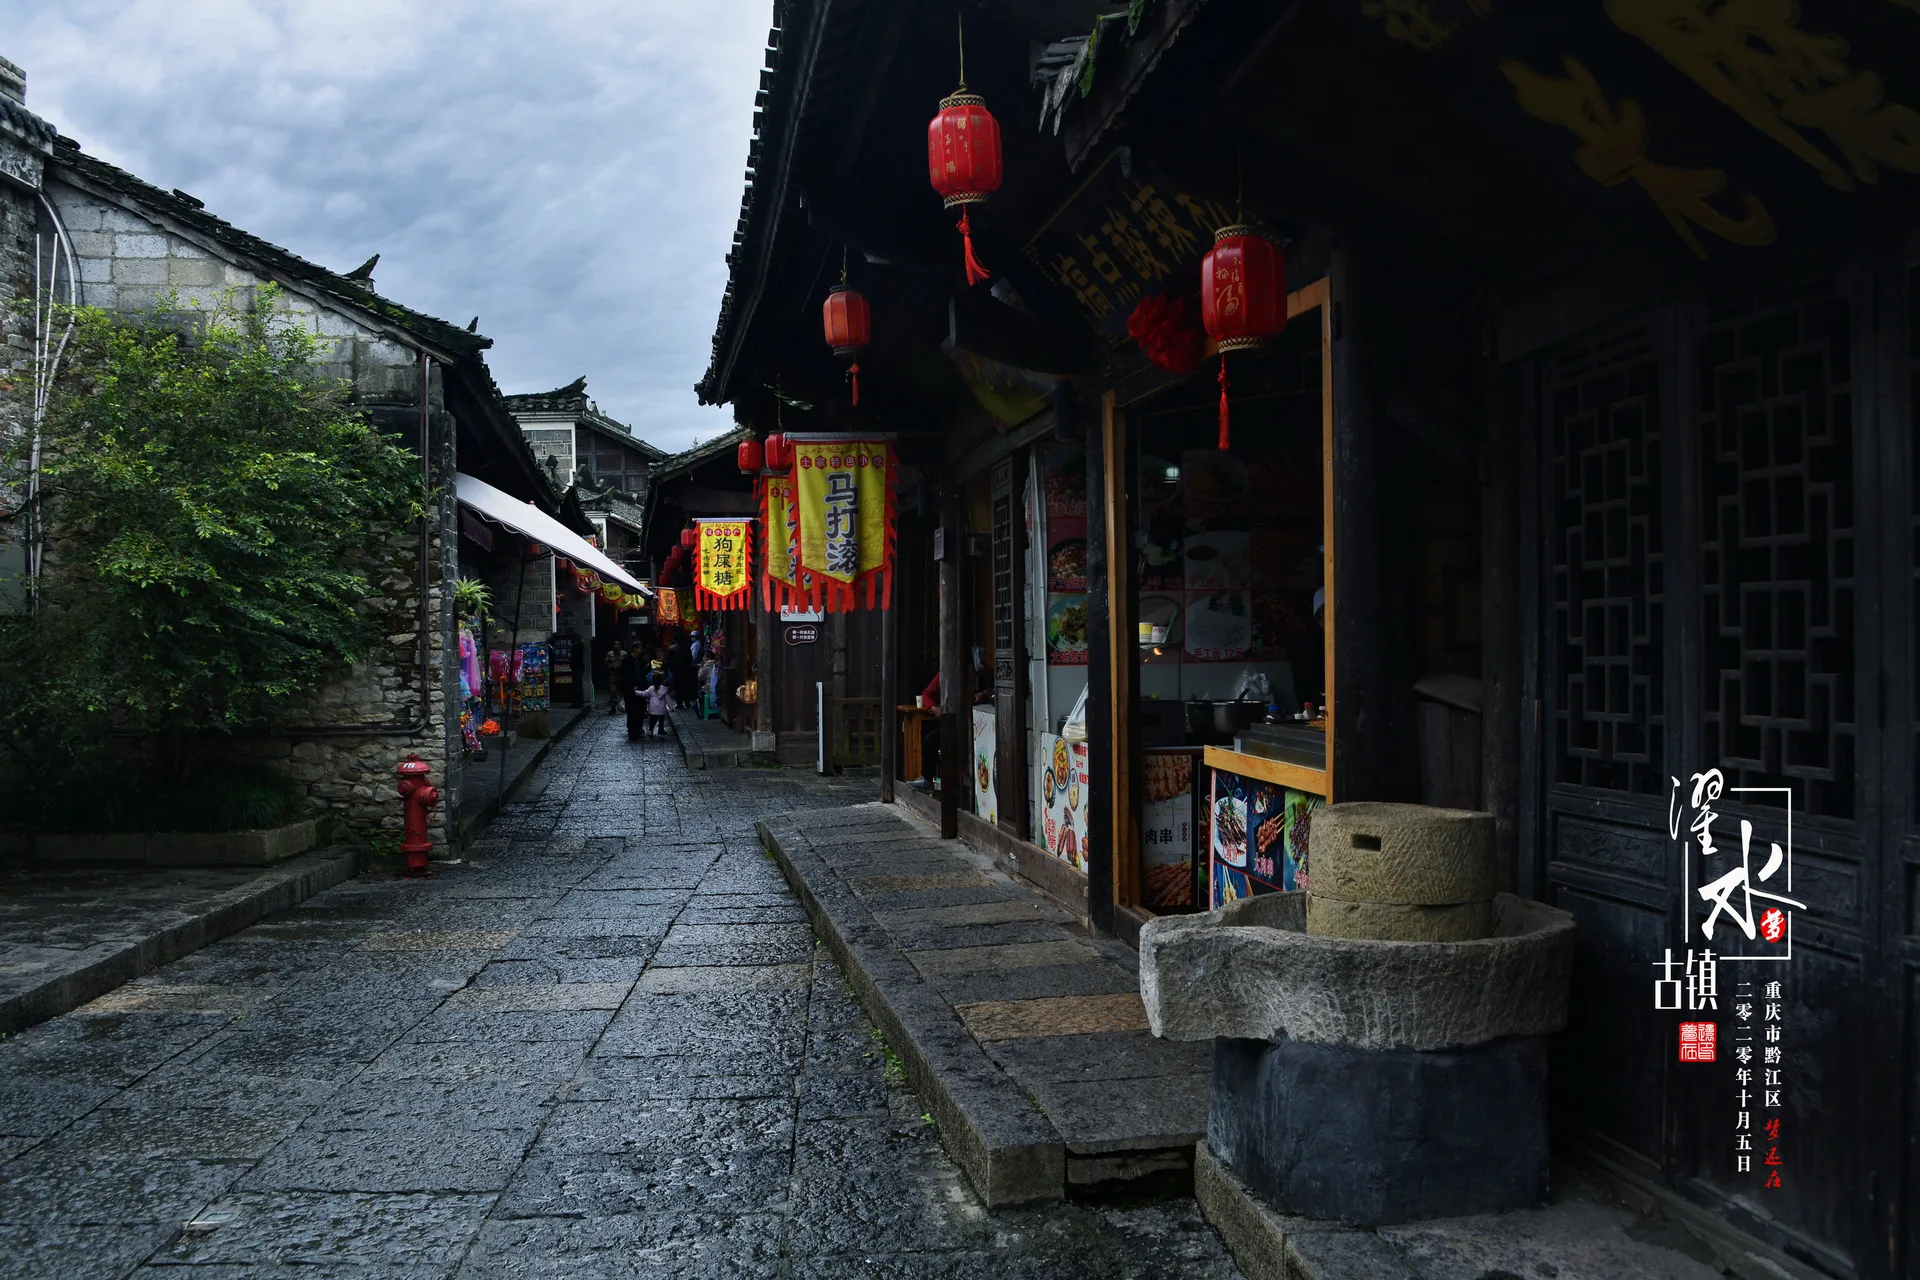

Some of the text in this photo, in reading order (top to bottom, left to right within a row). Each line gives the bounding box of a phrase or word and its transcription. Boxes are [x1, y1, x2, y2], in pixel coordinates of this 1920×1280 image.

[801, 455, 883, 468] 土家特色小吃
[823, 471, 860, 575] 马打滚
[1145, 828, 1172, 844] 肉串
